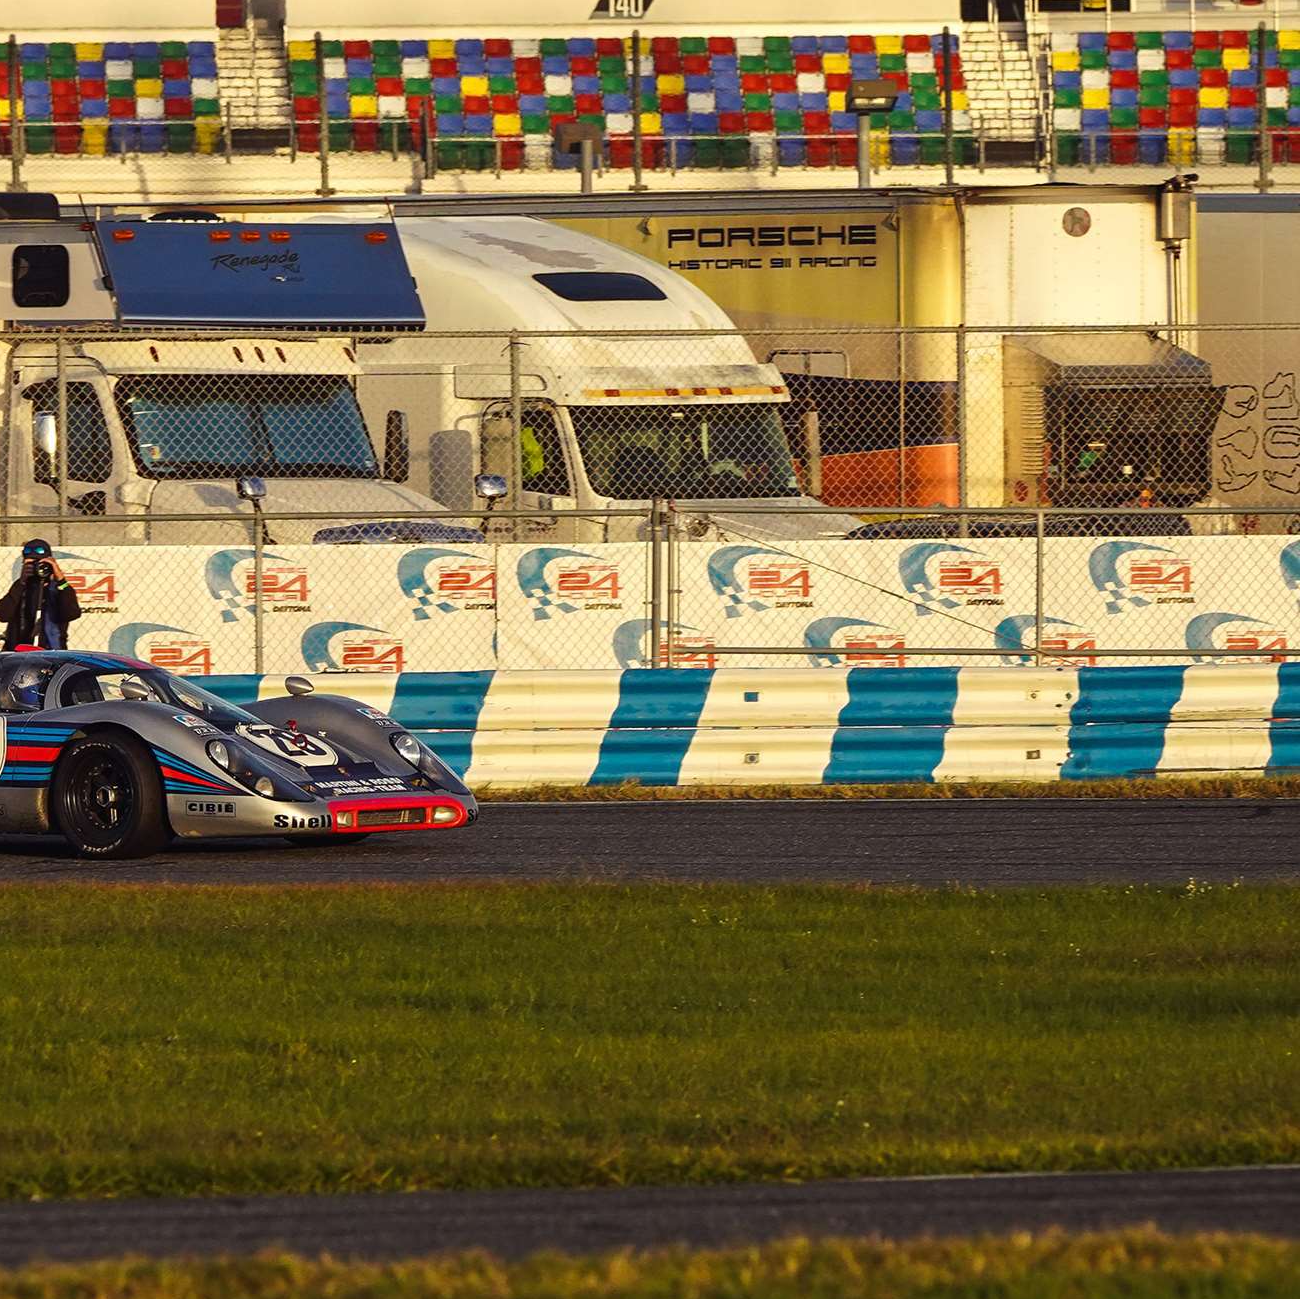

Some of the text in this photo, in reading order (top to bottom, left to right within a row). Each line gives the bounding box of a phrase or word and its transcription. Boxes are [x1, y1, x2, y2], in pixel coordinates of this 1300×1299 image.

[668, 225, 877, 248] PORSCHE
[210, 249, 299, 273] Renegade
[668, 256, 877, 270] HISTORIC 911 RACING
[246, 574, 311, 601] 24
[439, 572, 496, 599] 24
[558, 571, 623, 598] 24
[749, 570, 814, 597] 24
[940, 568, 1004, 594] 24
[1130, 566, 1194, 592] 24
[150, 647, 215, 674] 24
[343, 645, 407, 673] 24
[845, 641, 909, 667] 24
[1226, 637, 1288, 663] 24
